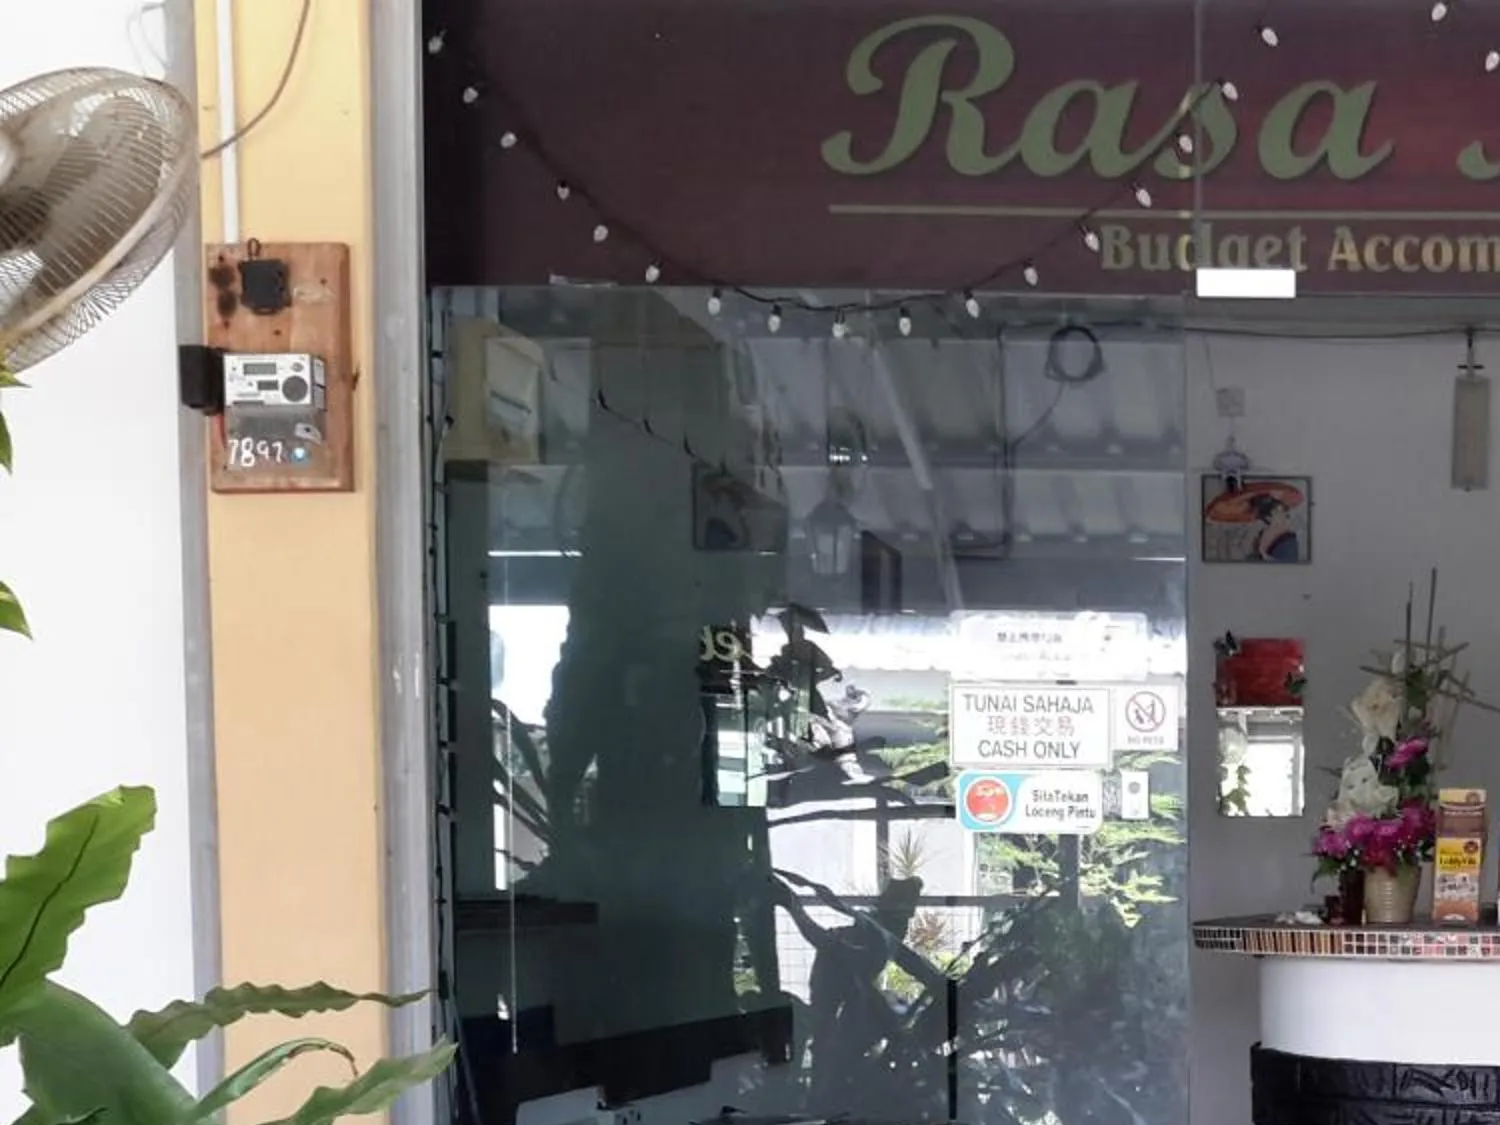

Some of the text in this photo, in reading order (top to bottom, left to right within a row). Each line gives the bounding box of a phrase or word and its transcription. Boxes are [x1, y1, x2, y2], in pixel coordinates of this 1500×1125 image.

[821, 14, 1394, 180] Rasa
[1100, 222, 1308, 272] Budget
[962, 694, 1095, 714] TUNAI SAHAJA
[977, 739, 1081, 759] CASH ONLY
